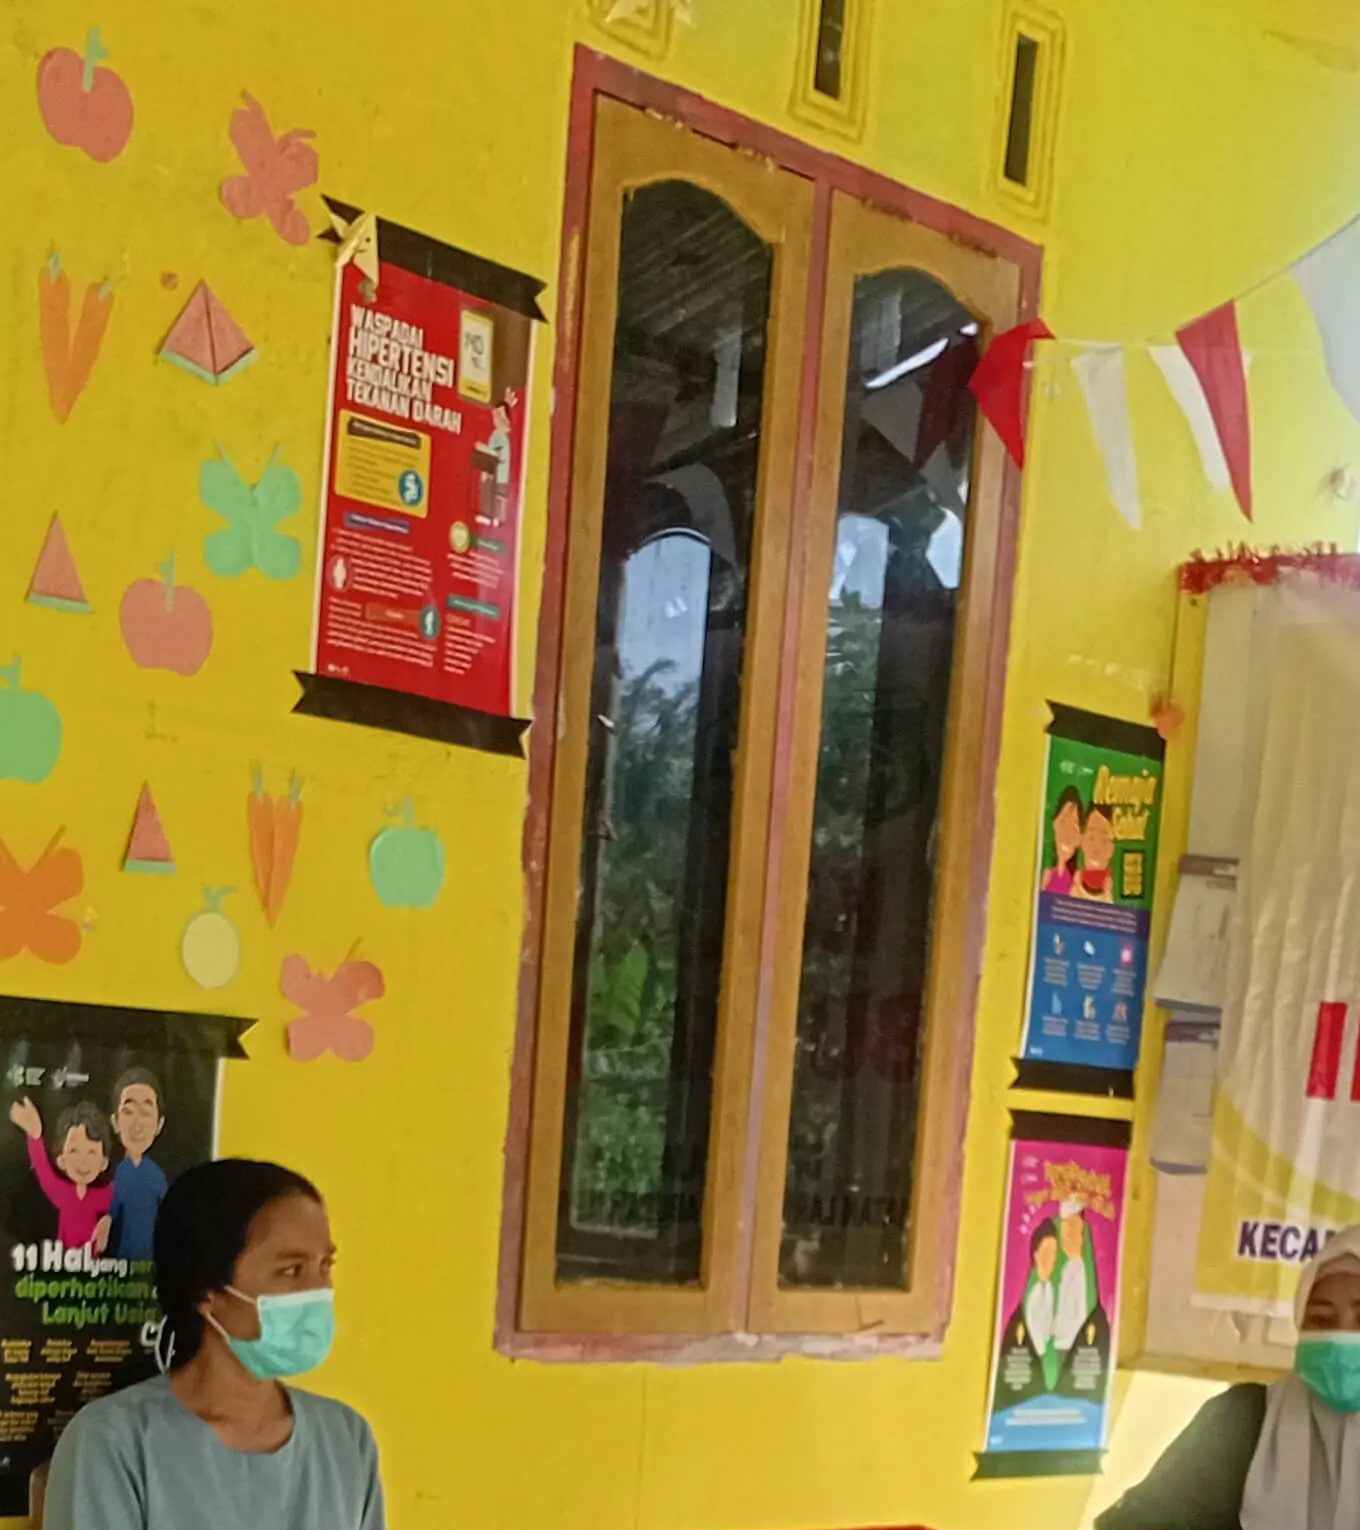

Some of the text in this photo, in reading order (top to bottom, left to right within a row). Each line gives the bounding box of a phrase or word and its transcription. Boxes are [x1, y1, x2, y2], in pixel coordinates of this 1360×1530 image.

[351, 304, 423, 350] WASPADAI
[349, 326, 454, 387] HIPERTENSI
[348, 357, 432, 402] KENDALIKAN
[347, 378, 411, 419] TEKANAN
[412, 399, 462, 434] DARAH
[11, 1243, 38, 1272] 11
[42, 1239, 92, 1272] Hal
[90, 1258, 127, 1278] yang
[1236, 1221, 1338, 1262] KECA
[15, 1273, 151, 1304] diperhatikan
[42, 1300, 110, 1329] Lanjut
